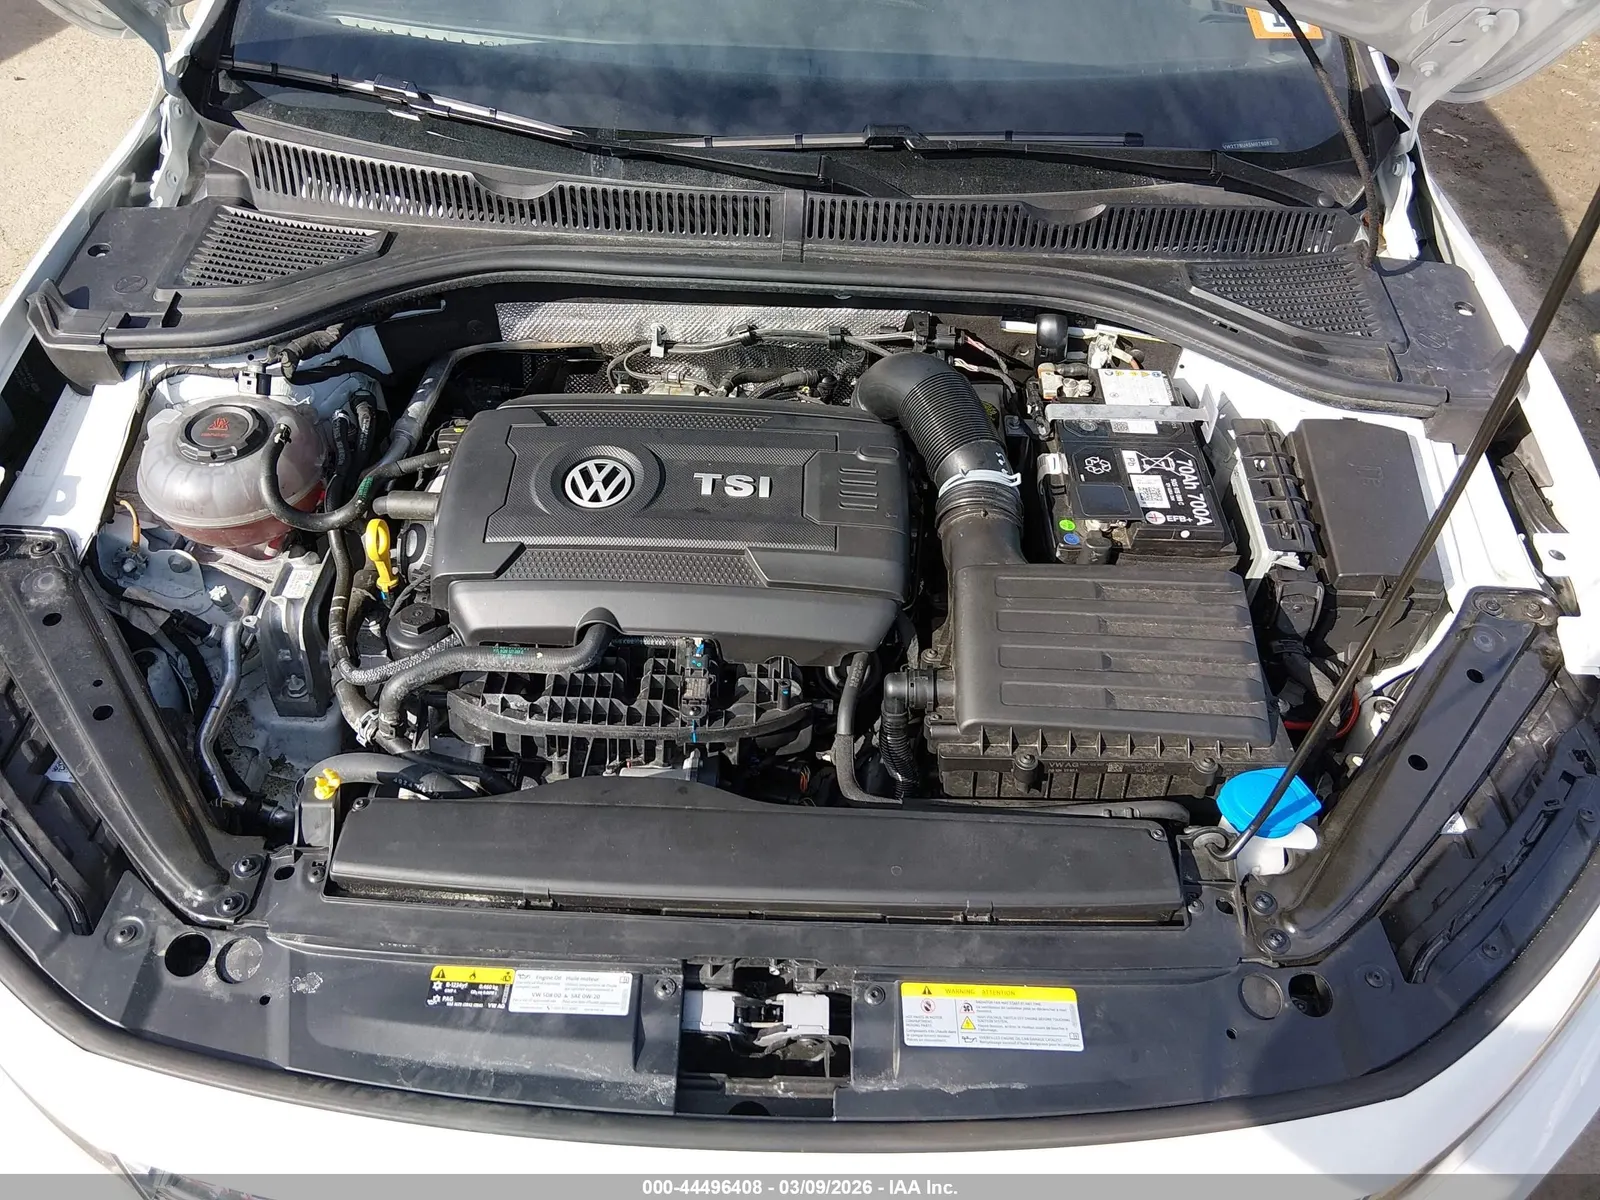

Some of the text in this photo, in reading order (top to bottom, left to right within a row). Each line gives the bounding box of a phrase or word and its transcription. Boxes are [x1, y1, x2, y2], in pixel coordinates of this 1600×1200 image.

[1125, 457, 1135, 467] Pb
[1176, 459, 1200, 490] 70Ah
[693, 472, 771, 498] TSI
[1166, 515, 1193, 523] EFB+
[1187, 493, 1213, 526] 700A
